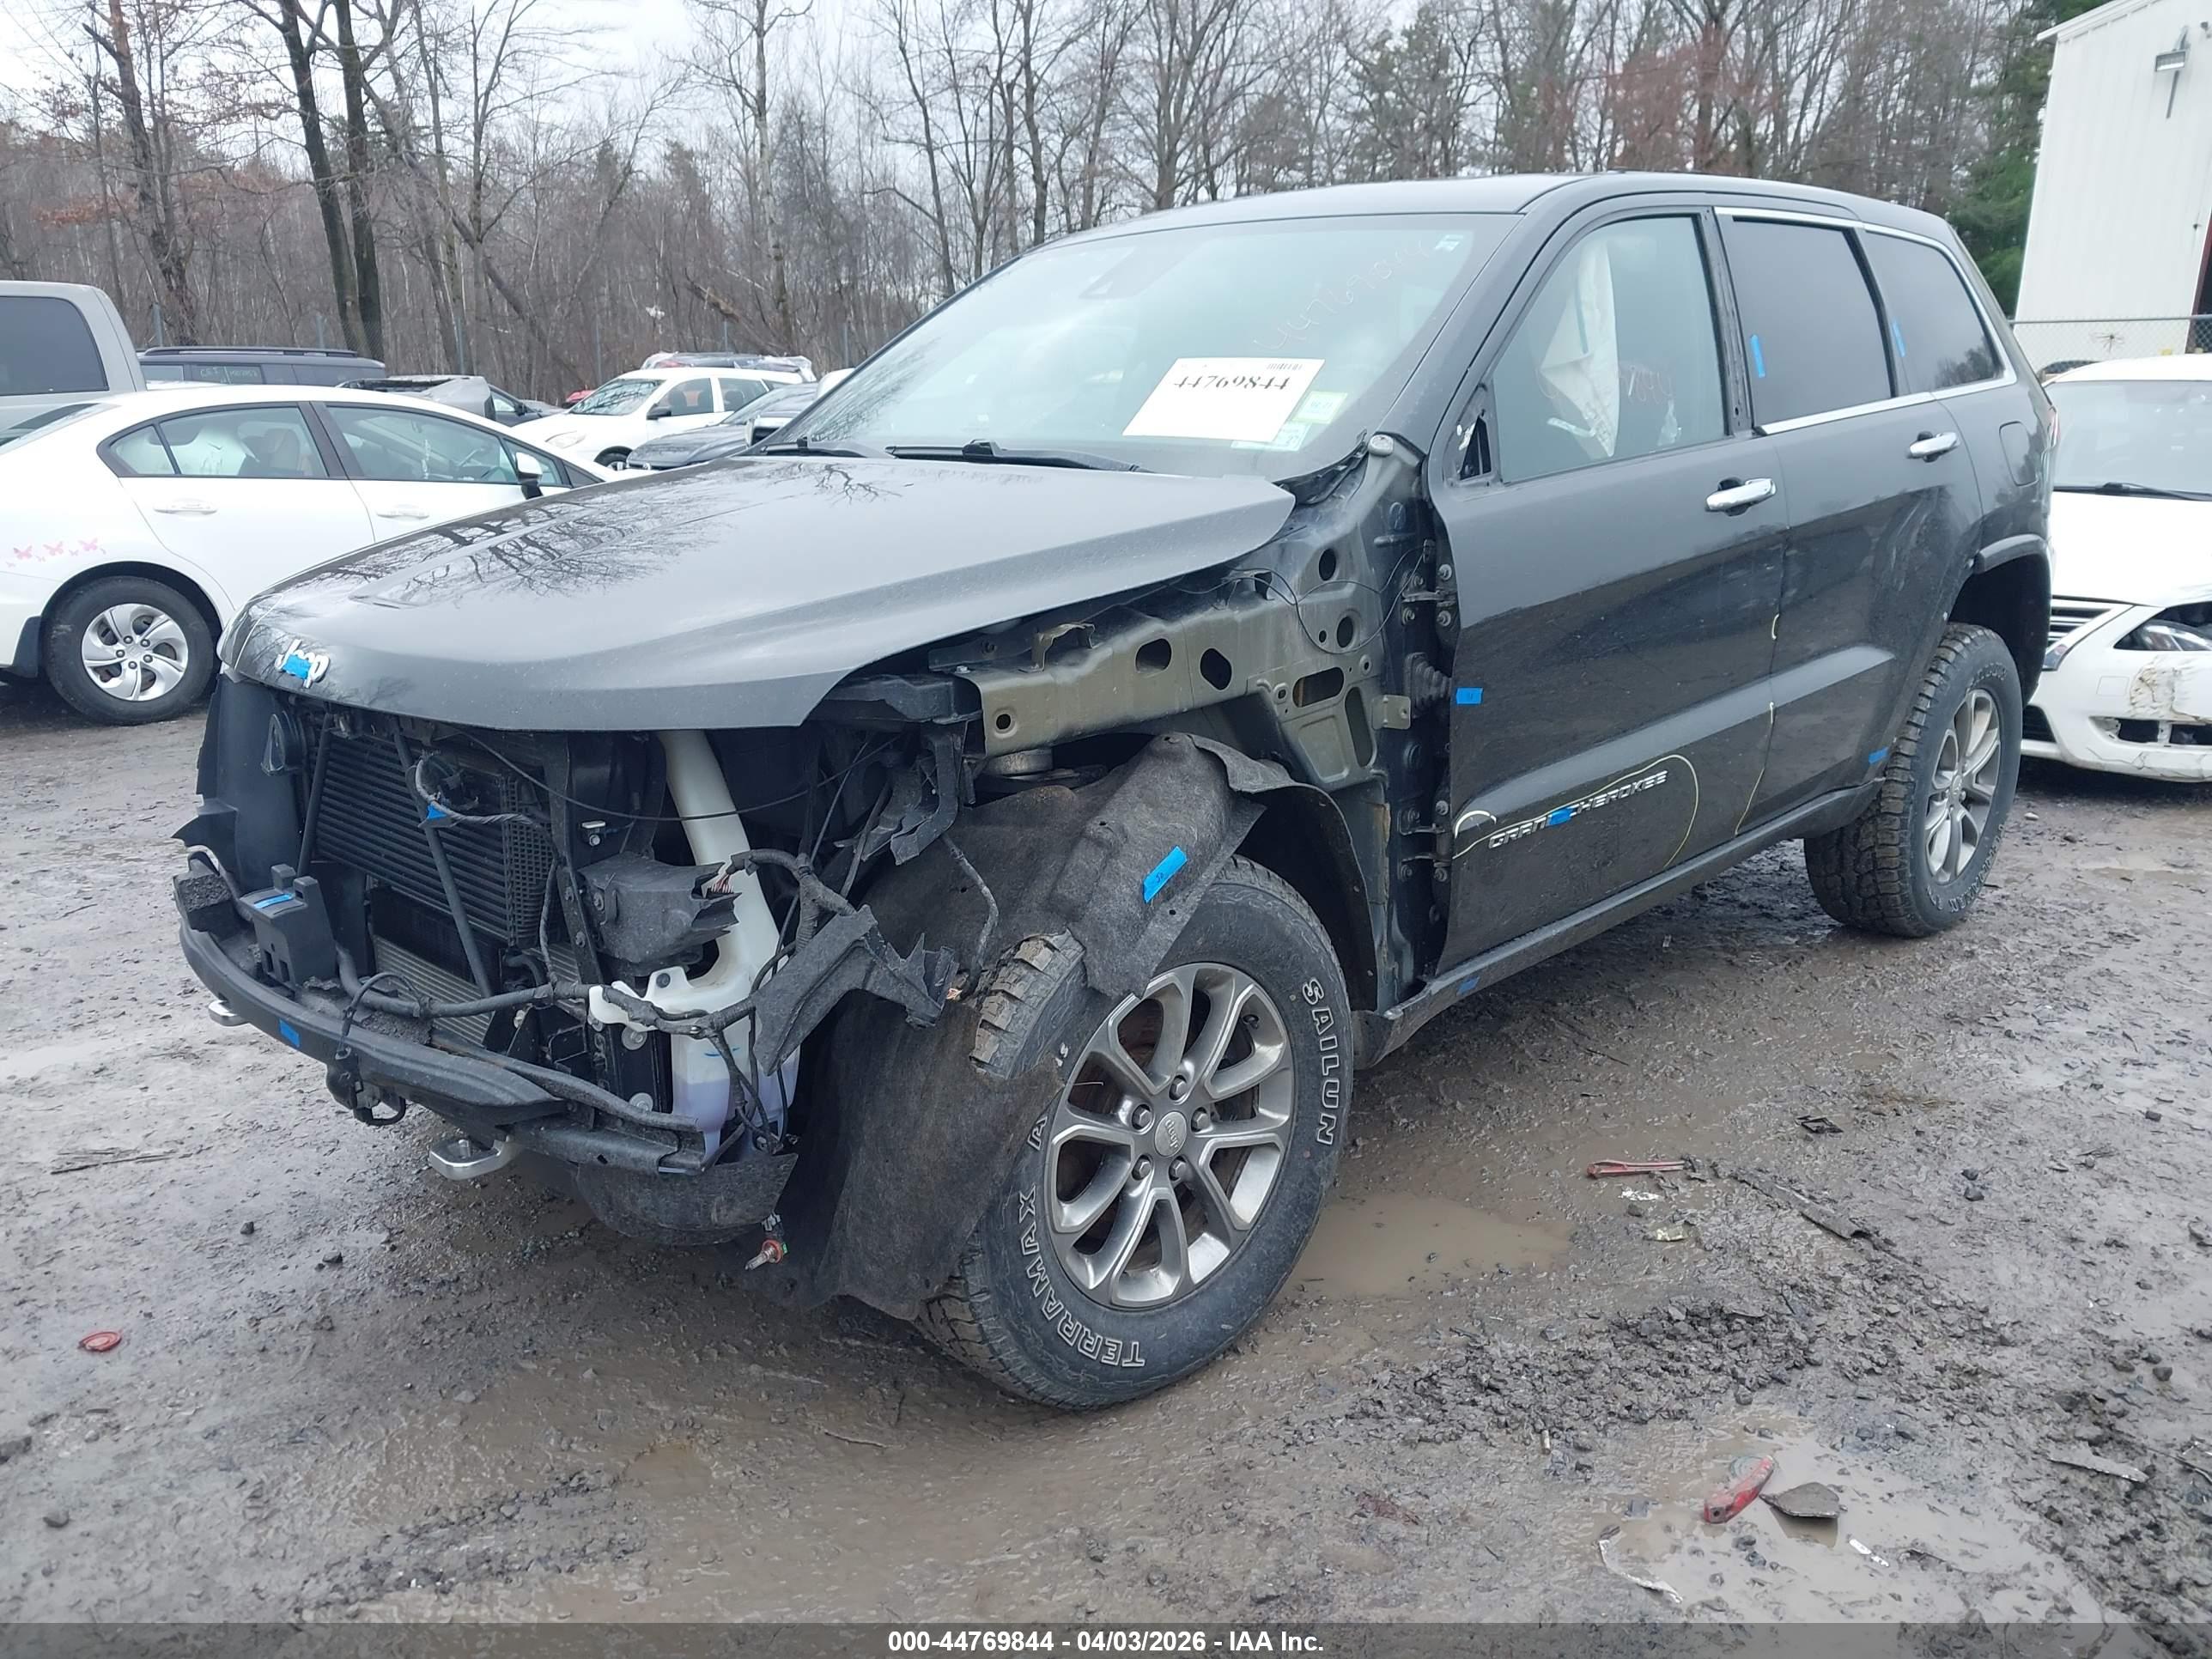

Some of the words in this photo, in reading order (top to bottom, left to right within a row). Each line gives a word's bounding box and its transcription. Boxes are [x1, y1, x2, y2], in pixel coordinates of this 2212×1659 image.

[1173, 375, 1291, 391] 44769844
[1488, 814, 1553, 848] GRAN
[1302, 976, 1341, 1146] SAILUN
[1018, 1185, 1146, 1368] TERRAMAX
